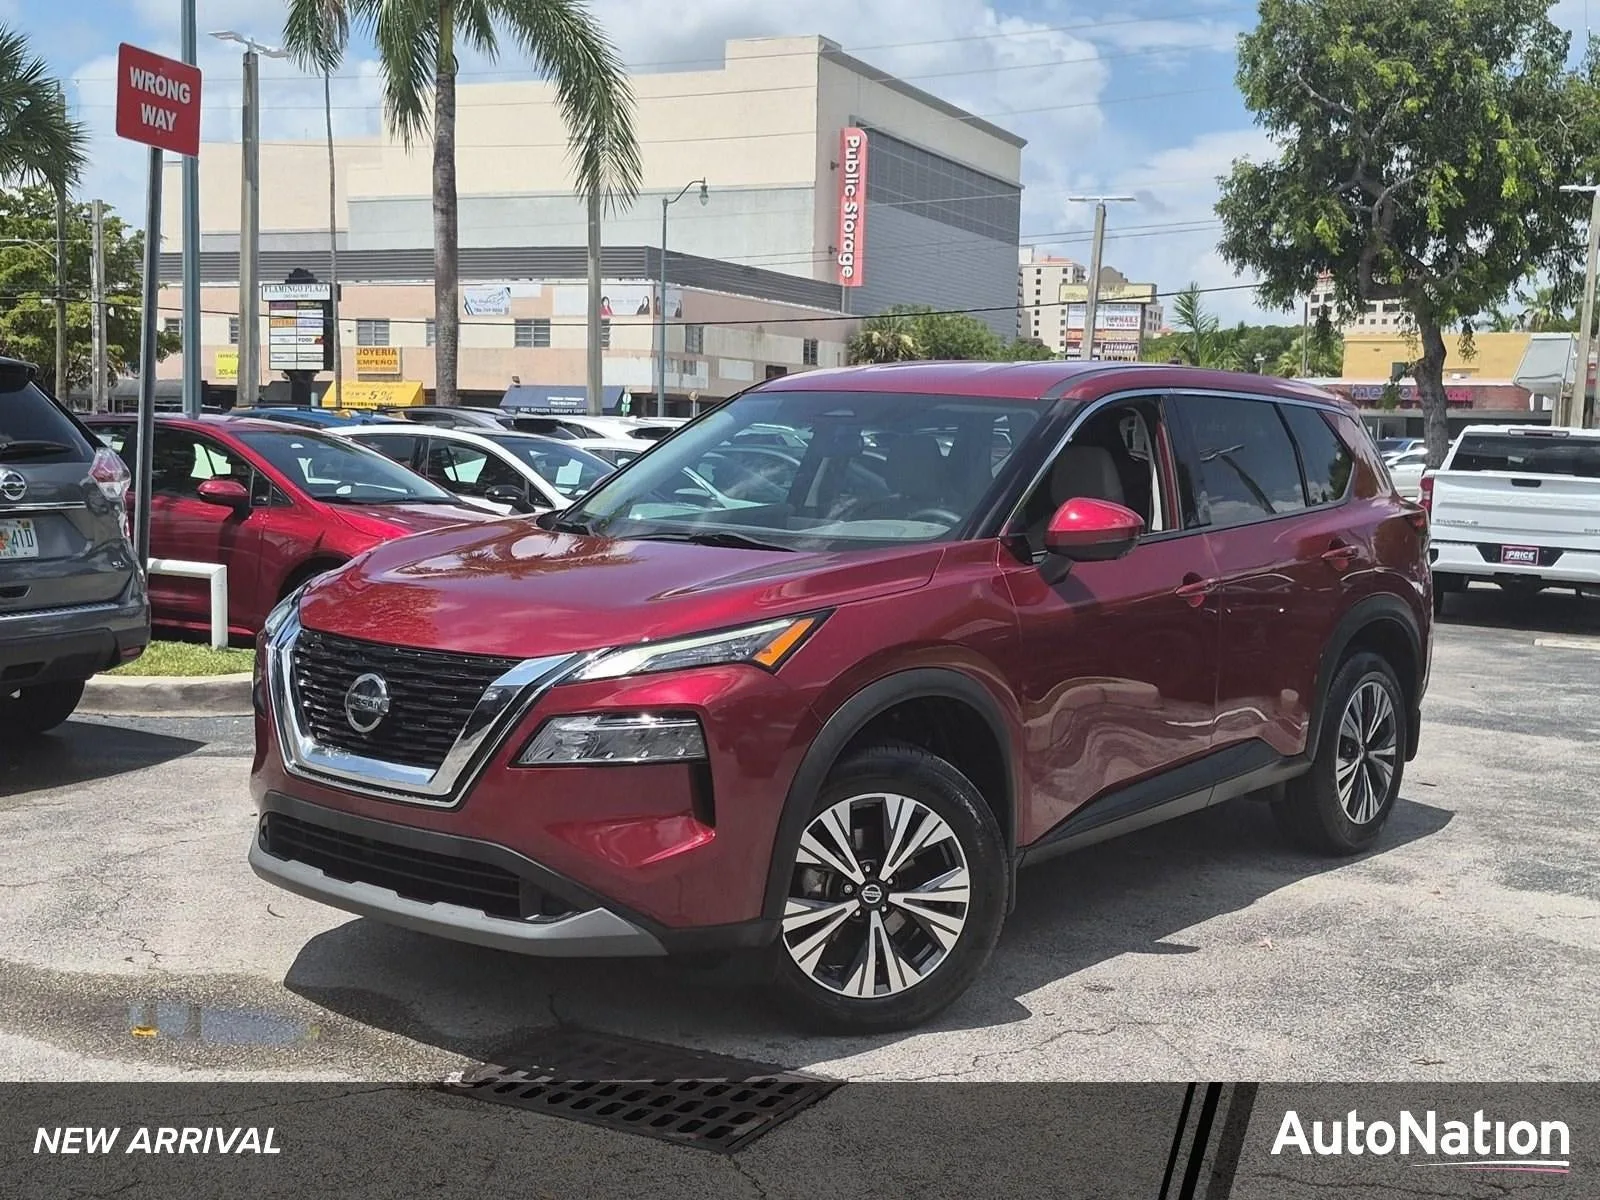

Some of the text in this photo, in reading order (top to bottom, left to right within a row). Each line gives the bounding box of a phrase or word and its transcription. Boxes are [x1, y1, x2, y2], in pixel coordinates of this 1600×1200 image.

[129, 66, 191, 105] WRONG
[140, 102, 177, 132] WAY
[838, 135, 861, 279] Public Storage
[264, 284, 329, 293] FLAMINGO PLAZA
[356, 347, 398, 356] JOYERIA
